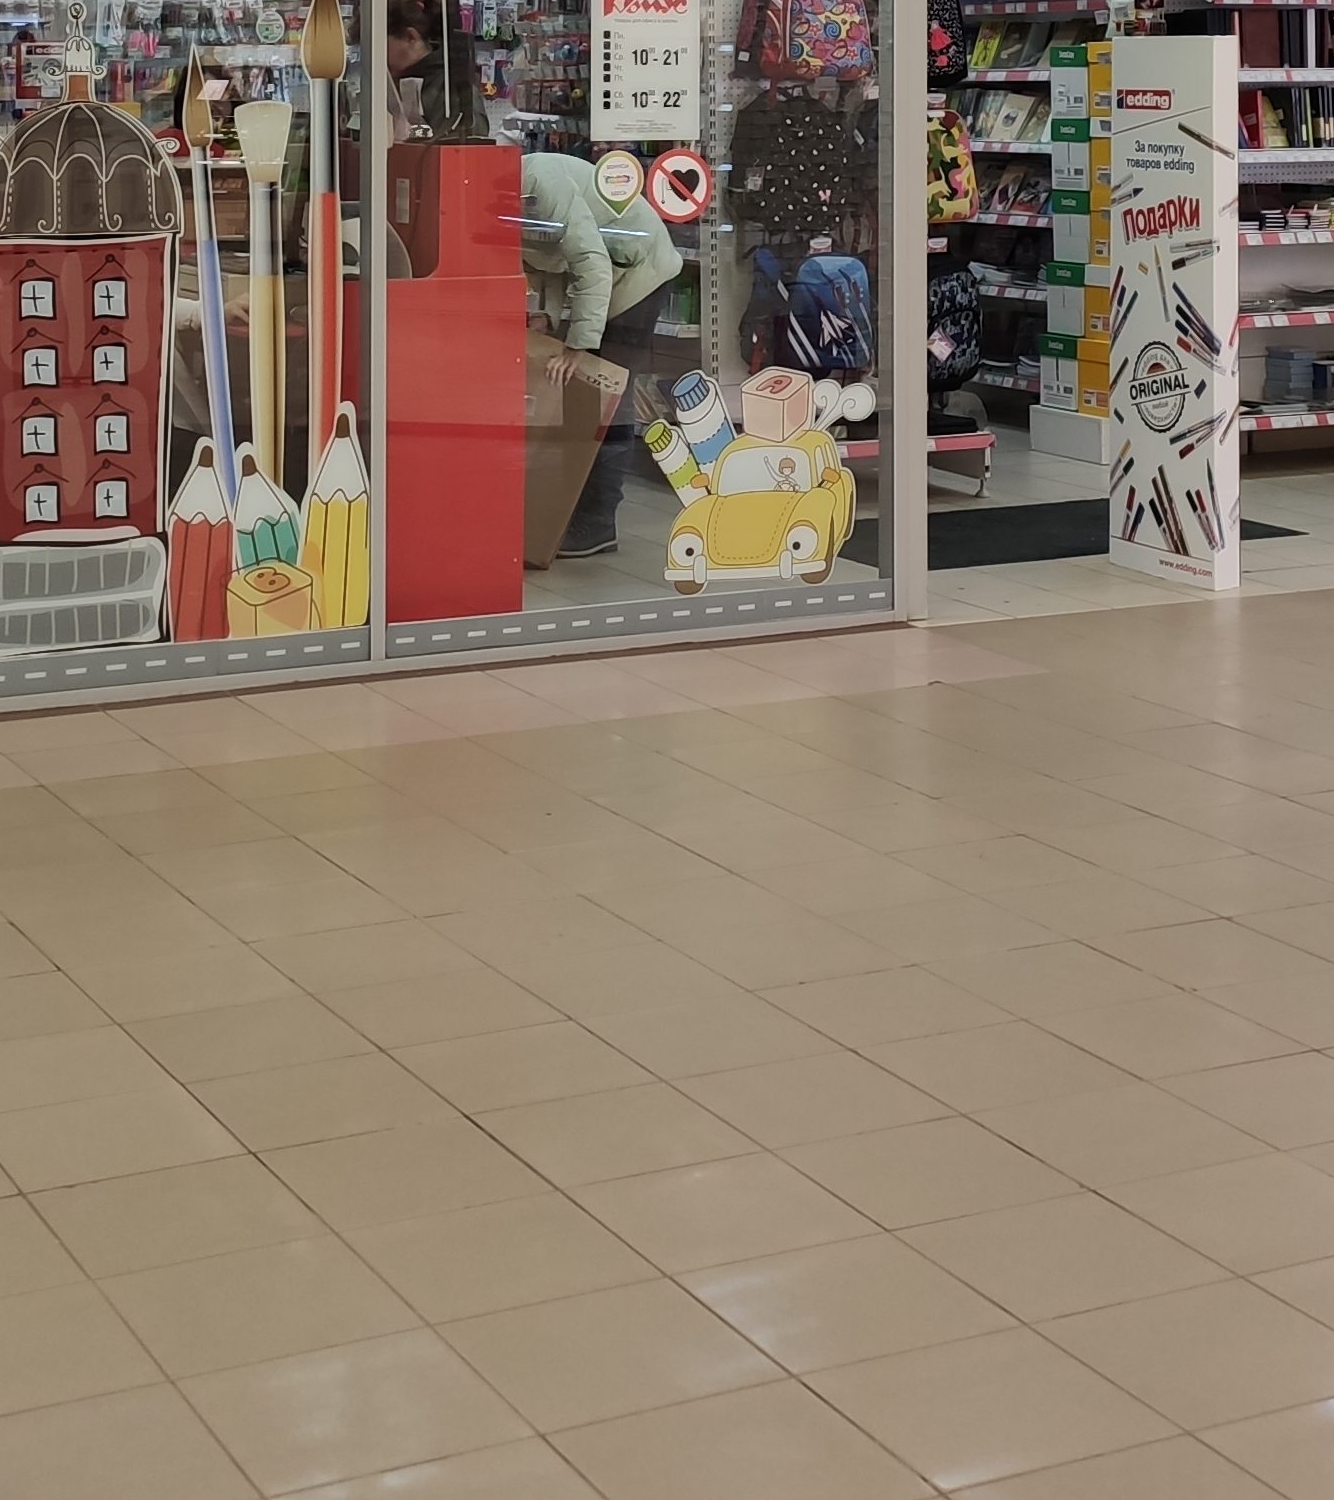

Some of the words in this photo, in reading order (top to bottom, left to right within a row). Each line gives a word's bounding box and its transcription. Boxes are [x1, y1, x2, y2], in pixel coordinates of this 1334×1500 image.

[1127, 92, 1170, 109] edding
[1134, 140, 1146, 153] За
[1147, 142, 1185, 158] покупку
[1126, 158, 1162, 171] товаров
[1164, 159, 1195, 174] edding
[1129, 372, 1190, 401] ORIGINAL
[1158, 558, 1213, 578] www.edding.com
